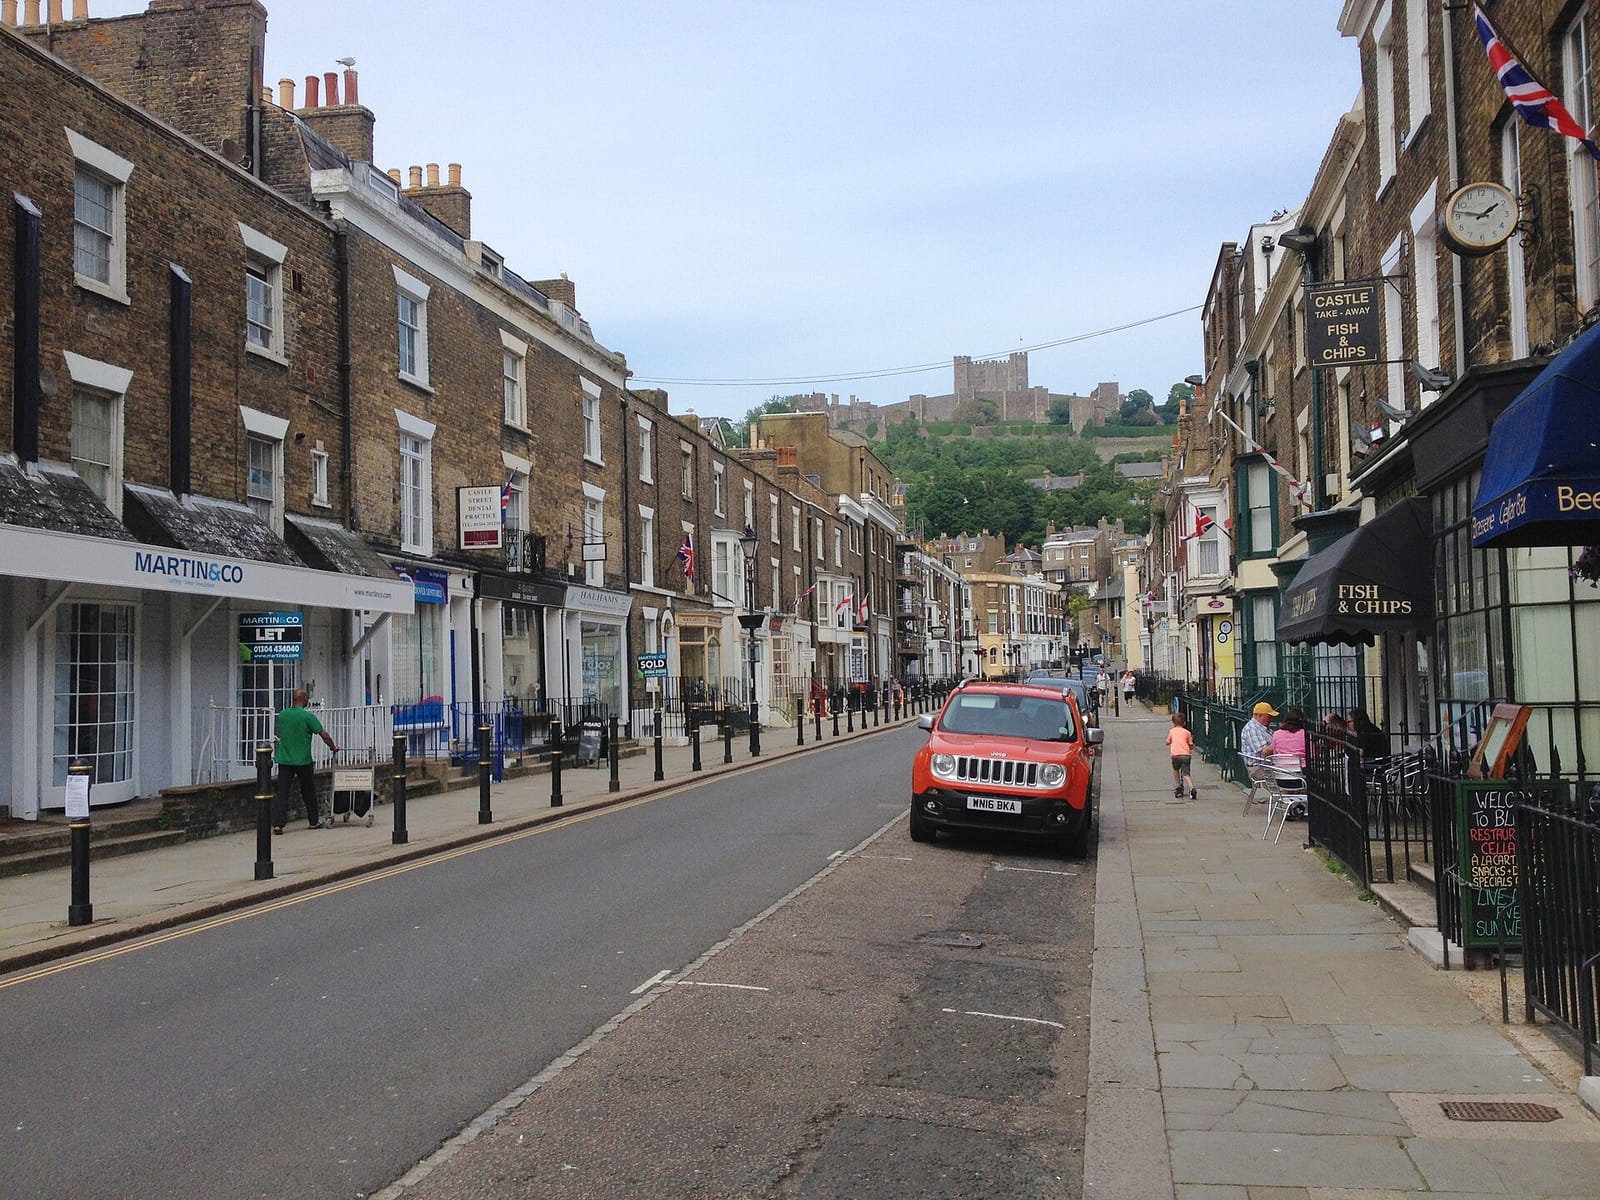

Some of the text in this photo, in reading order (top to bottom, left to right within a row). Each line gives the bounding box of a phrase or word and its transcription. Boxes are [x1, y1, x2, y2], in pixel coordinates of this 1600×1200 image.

[1466, 192, 1473, 200] 11
[1477, 189, 1486, 197] 12
[1457, 201, 1467, 209] 10
[1500, 199, 1506, 207] 2
[1503, 210, 1510, 218] 3
[1458, 223, 1465, 231] 8
[1498, 221, 1505, 229] 4
[1492, 230, 1498, 238] 5
[1315, 292, 1369, 308] CASTLE
[1315, 309, 1338, 319] TAKE
[1345, 306, 1370, 316] AWAY
[1327, 322, 1359, 336] FISH
[1339, 335, 1349, 347] &
[1322, 345, 1366, 360] CHIPS
[135, 551, 243, 584] MARTIN&CO
[580, 591, 619, 603] HALHAMS
[1338, 584, 1379, 599] FISH
[1338, 600, 1412, 614] & CHIPS
[255, 628, 285, 641] LET
[253, 645, 273, 653] 01304
[640, 660, 665, 669] SOLD
[972, 797, 1016, 812] WN16 BKA
[1475, 791, 1514, 809] WELC
[1472, 811, 1489, 827] TO
[1470, 827, 1516, 841] RESTAUR
[1480, 841, 1516, 855] CELLA
[1493, 854, 1517, 866] CART
[1472, 865, 1506, 877] SNACKS
[1473, 876, 1513, 888] SPECIALS
[1477, 887, 1507, 906] LIVE
[1496, 905, 1521, 920] EVE
[1503, 919, 1522, 936] WE
